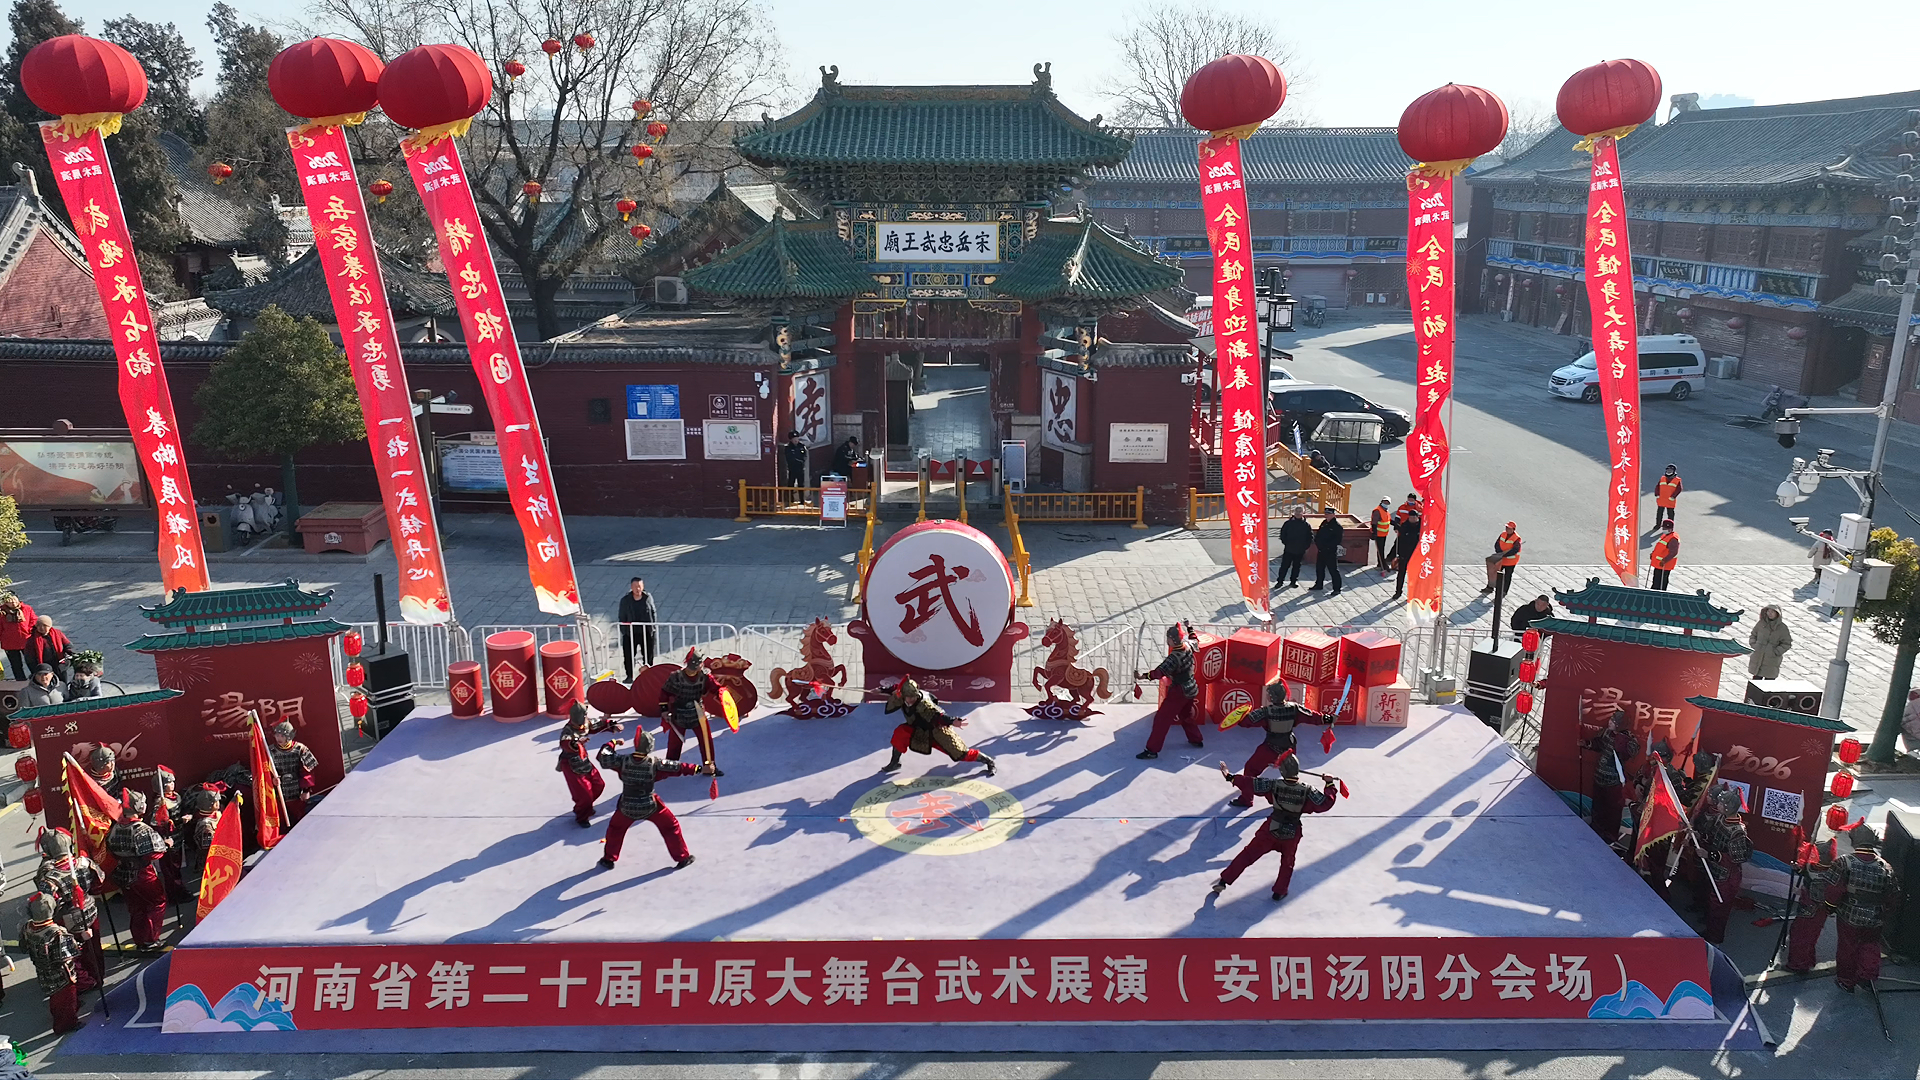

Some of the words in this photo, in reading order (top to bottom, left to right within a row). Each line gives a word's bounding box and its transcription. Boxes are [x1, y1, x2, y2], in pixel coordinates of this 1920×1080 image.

[884, 230, 991, 253] 宋岳忠武王廟
[1640, 368, 1684, 376] 阴急救
[797, 377, 825, 443] 孝
[1048, 376, 1074, 442] 忠
[894, 553, 984, 647] 武
[1204, 648, 1222, 678] 福
[1286, 645, 1315, 667] 团团
[496, 671, 515, 688] 福
[552, 676, 569, 689] 福
[455, 687, 468, 698] 福
[1322, 703, 1353, 714] 马岁祥
[1378, 692, 1398, 723] 新春
[1718, 744, 1801, 780] 2026
